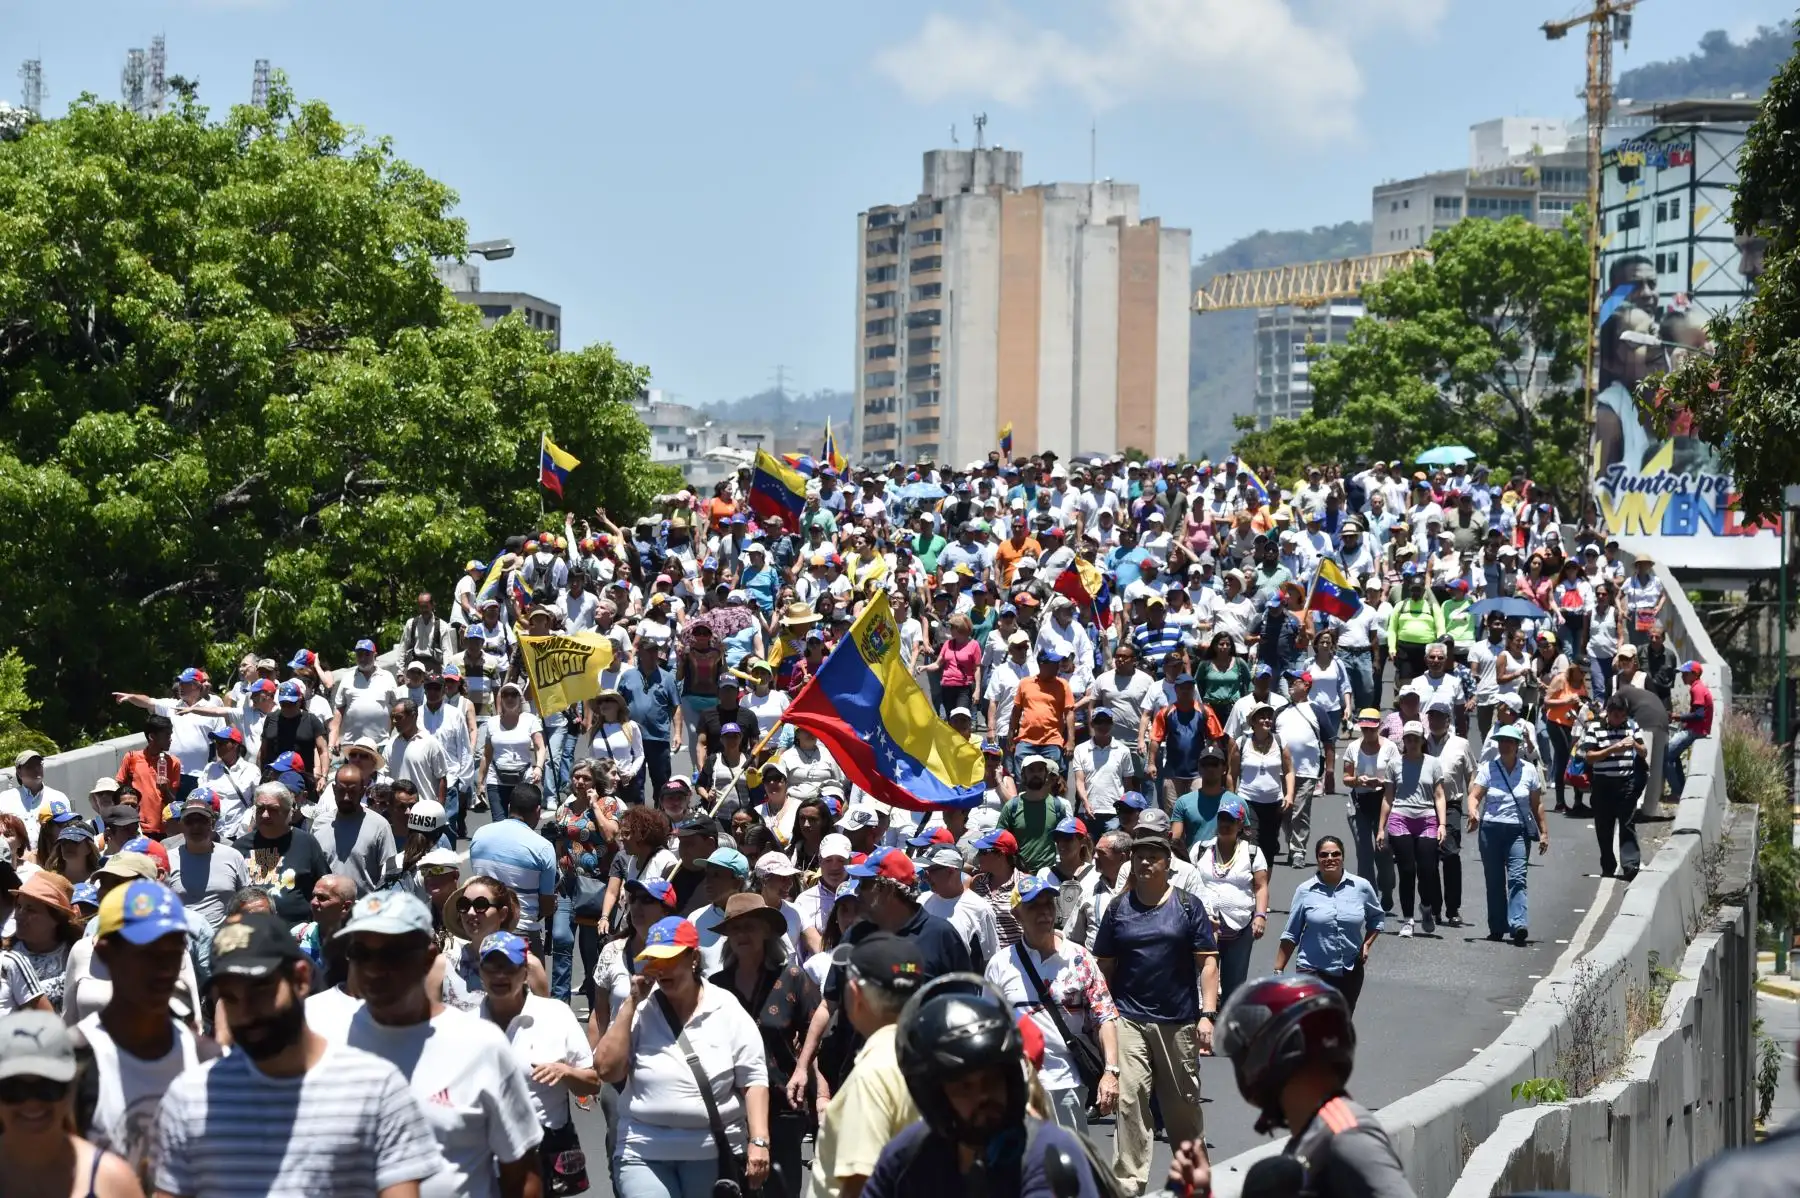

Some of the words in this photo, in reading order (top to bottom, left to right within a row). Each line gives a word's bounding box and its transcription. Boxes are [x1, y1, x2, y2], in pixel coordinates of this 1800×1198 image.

[1599, 465, 1689, 498] Juntos
[1694, 473, 1733, 504] po
[408, 813, 437, 828] RENSA
